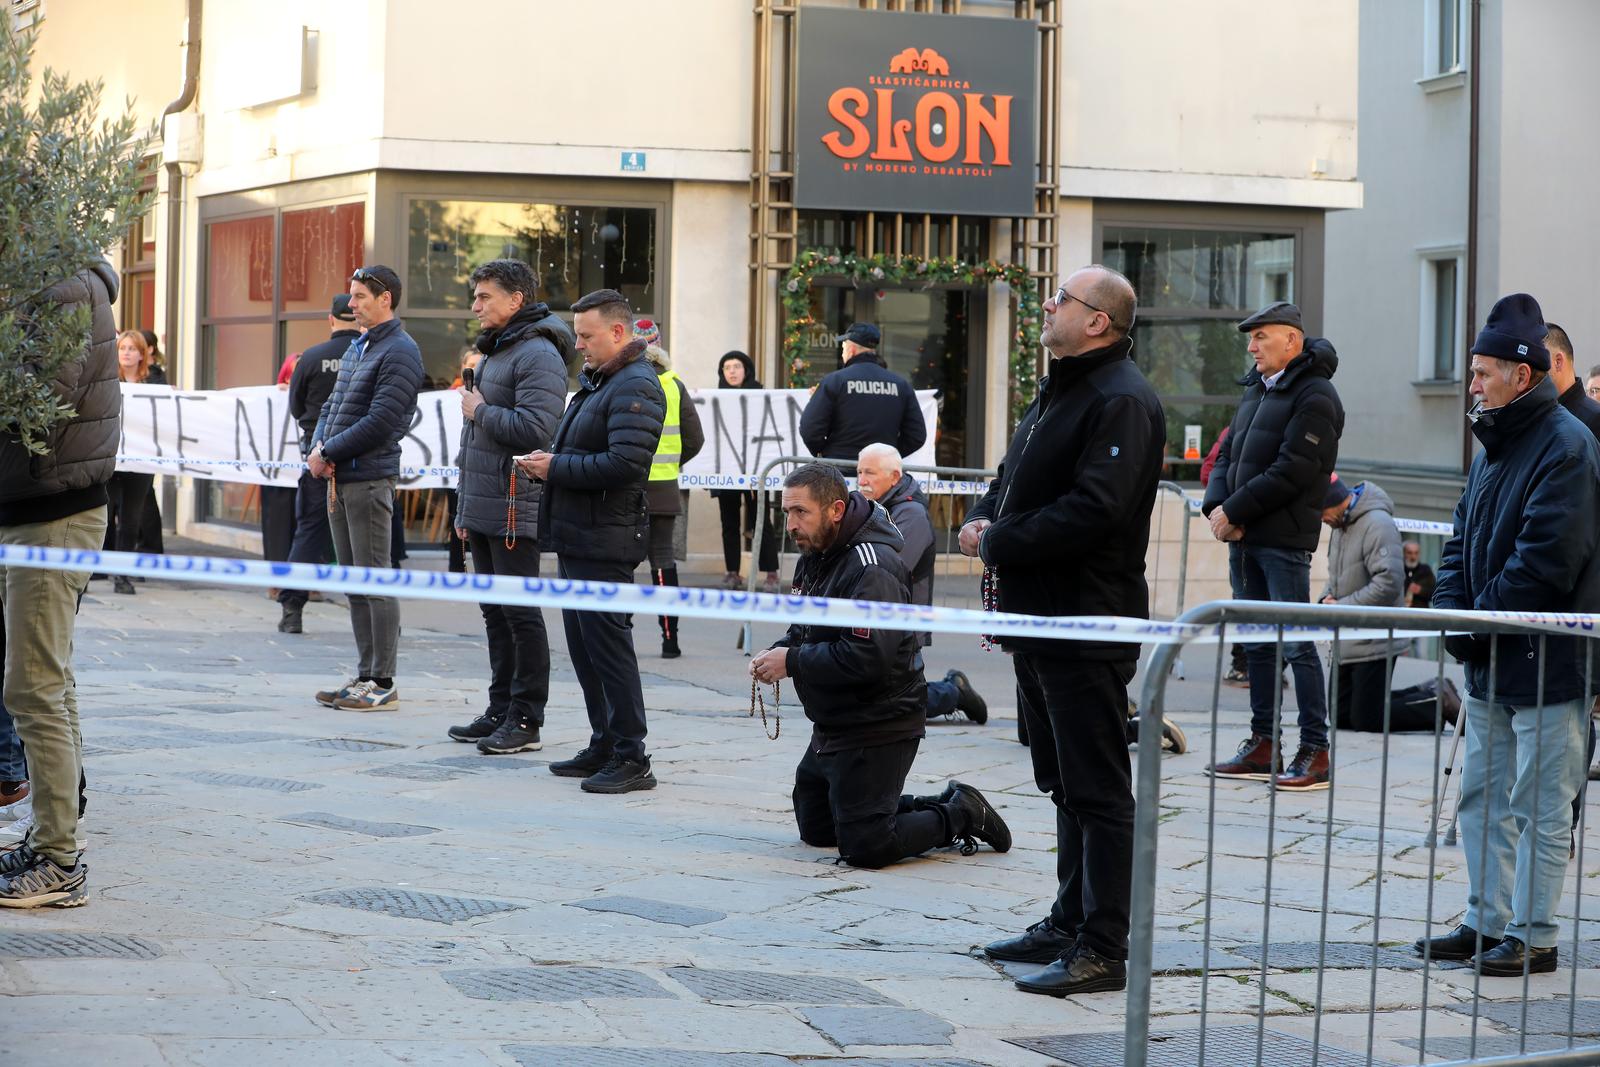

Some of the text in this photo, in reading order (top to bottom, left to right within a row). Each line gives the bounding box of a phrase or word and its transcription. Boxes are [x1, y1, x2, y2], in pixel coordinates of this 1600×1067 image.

[820, 87, 1014, 167] SLON
[628, 153, 638, 166] 4
[844, 163, 858, 172] BY
[865, 164, 917, 174] MORENO
[847, 380, 899, 396] POLICIJA
[681, 475, 734, 486] POLICIJA
